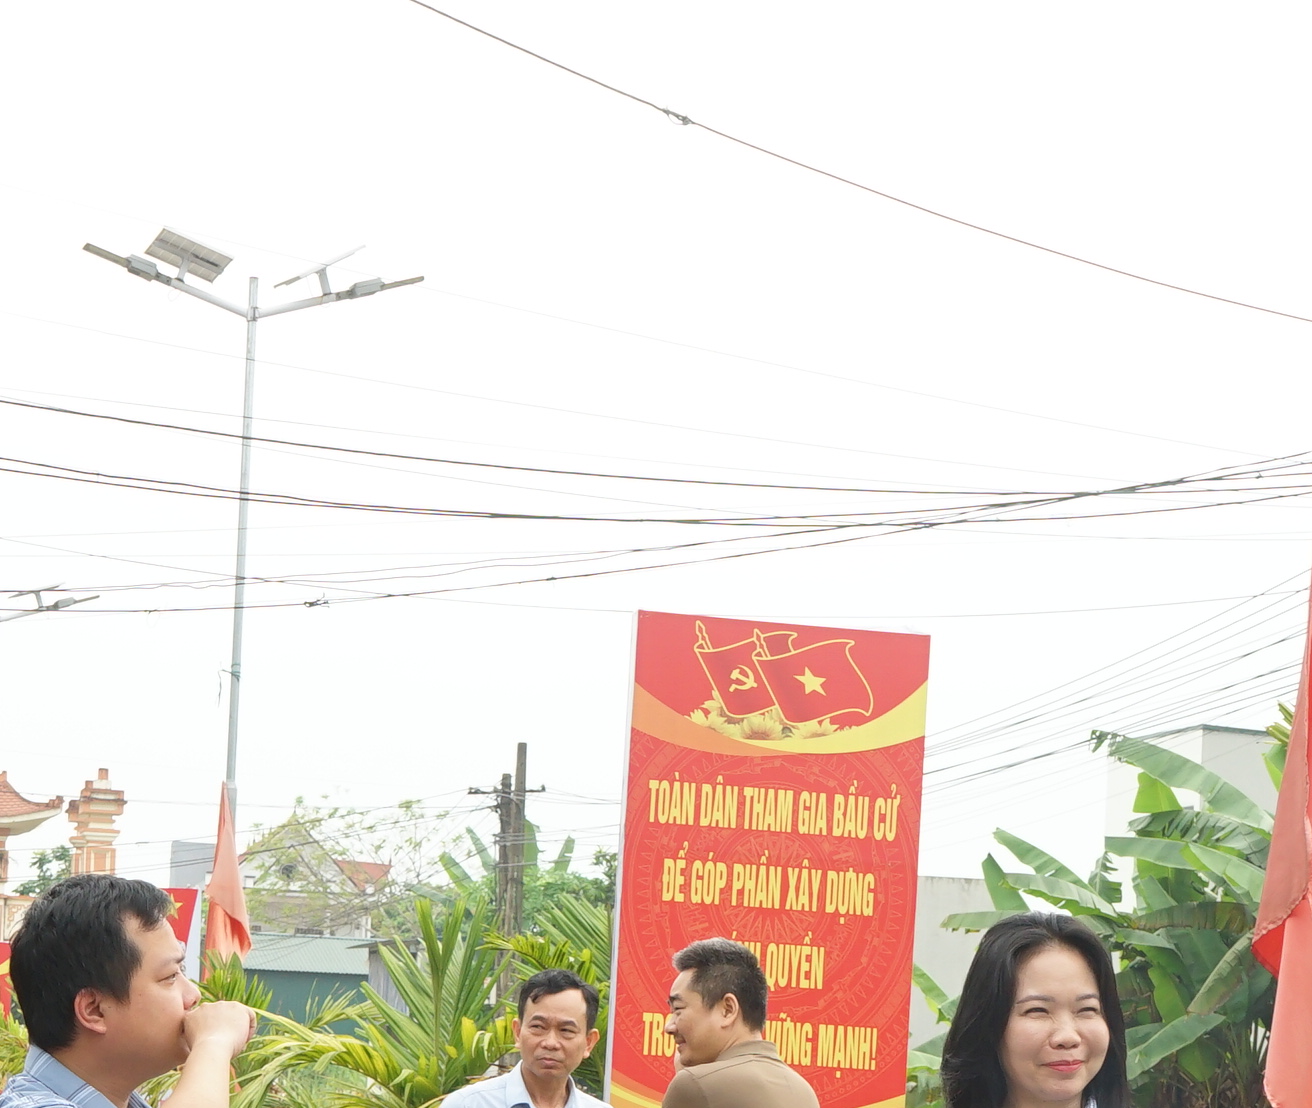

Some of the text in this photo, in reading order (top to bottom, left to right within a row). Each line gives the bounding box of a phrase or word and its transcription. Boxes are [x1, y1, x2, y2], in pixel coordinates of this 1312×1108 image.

[649, 771, 901, 842] TOÀN DÂN THAM GIA BẦU CỬ
[661, 841, 876, 925] ĐỂ GÓP PHẦN XÂY DỰNG
[765, 931, 825, 992] QUYỀN
[642, 1011, 676, 1058] TRO
[816, 1023, 878, 1078] MẠNH!
